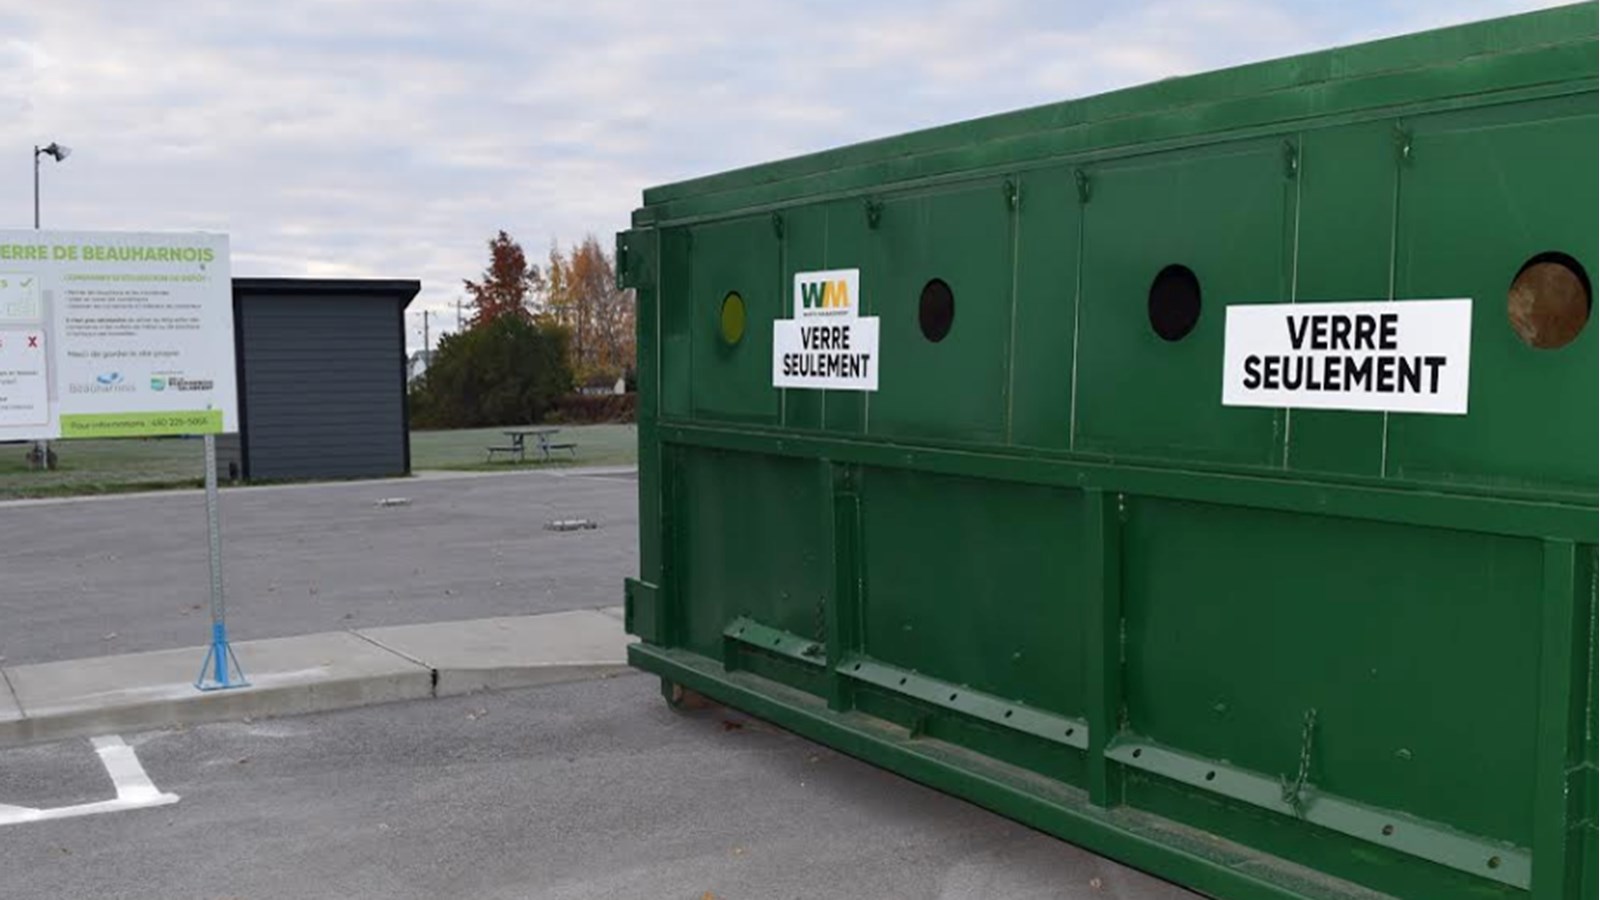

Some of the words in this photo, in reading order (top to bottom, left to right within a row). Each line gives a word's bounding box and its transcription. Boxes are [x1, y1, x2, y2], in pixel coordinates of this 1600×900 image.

[53, 245, 77, 261] DE
[82, 246, 214, 262] BEAUHARNOIS
[800, 325, 850, 350] VERRE
[1286, 313, 1398, 350] VERRE
[783, 353, 871, 378] SEULEMENT
[1242, 354, 1447, 394] SEULEMENT
